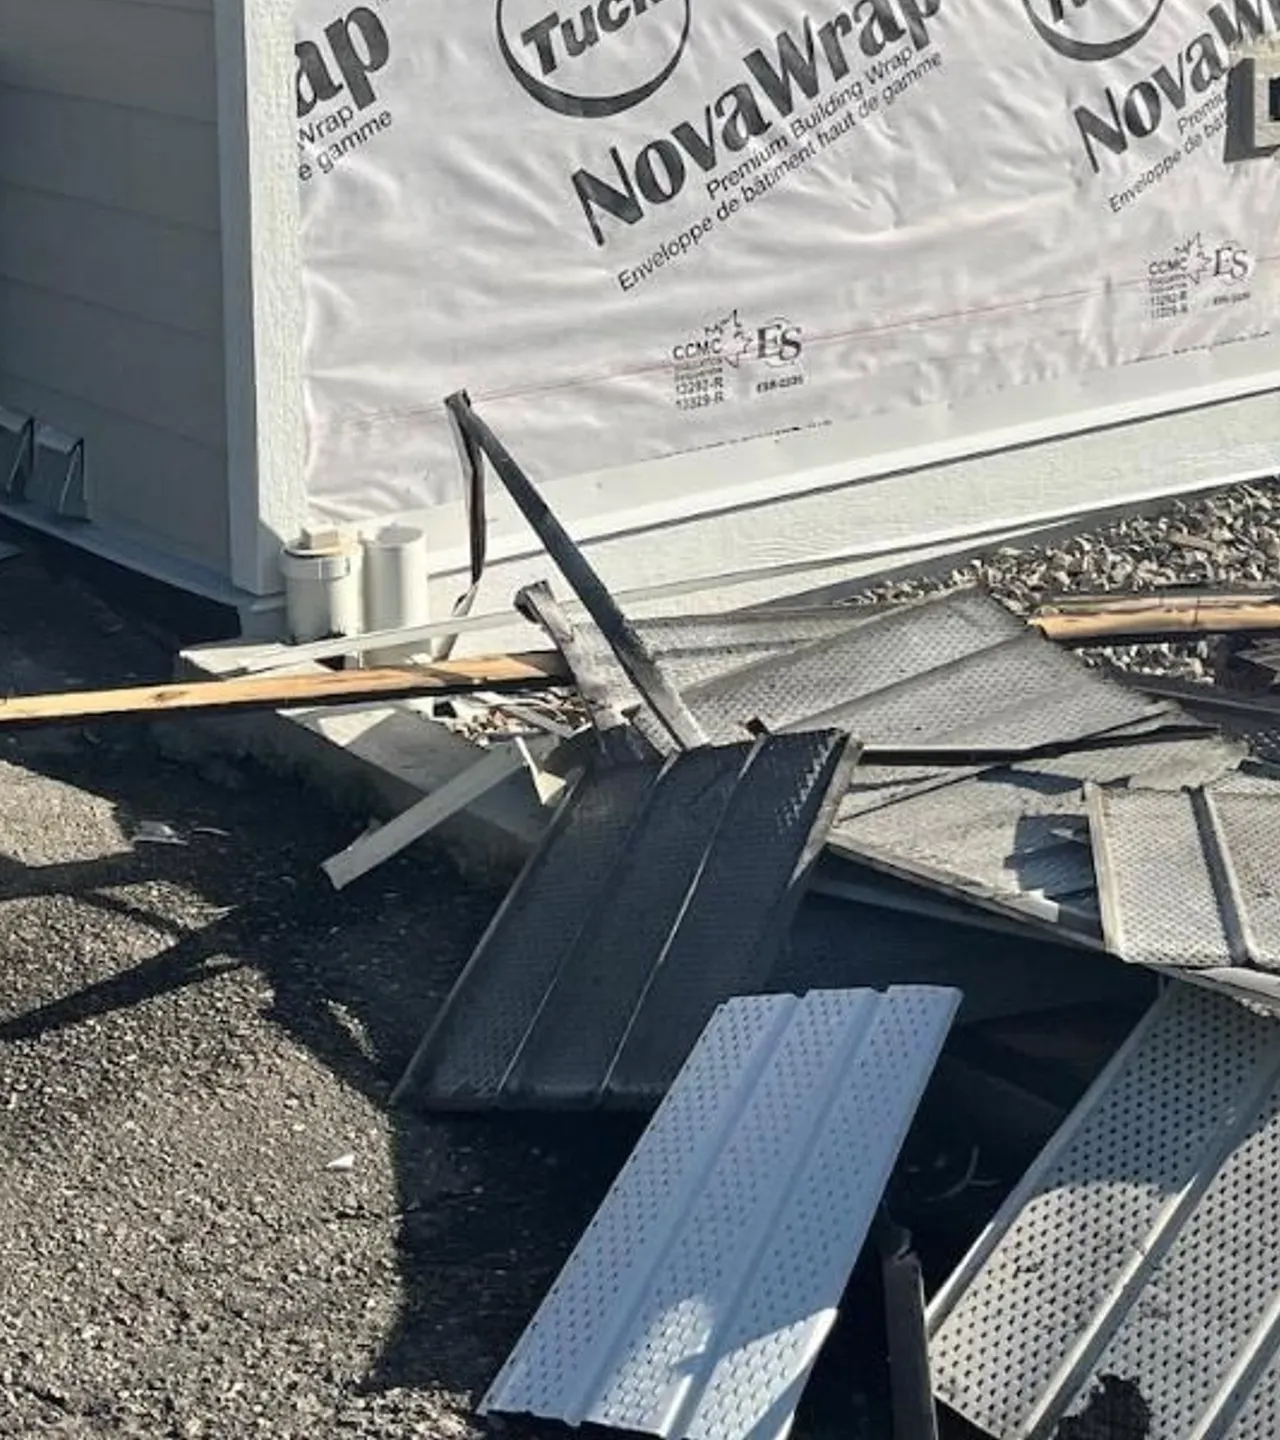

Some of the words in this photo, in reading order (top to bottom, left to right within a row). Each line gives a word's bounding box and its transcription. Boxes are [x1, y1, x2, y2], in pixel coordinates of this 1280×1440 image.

[316, 110, 393, 174] gamme
[705, 134, 790, 202] Premium
[789, 80, 865, 140] Building
[864, 45, 914, 92] Wrap
[617, 215, 714, 292] Enveloppe
[715, 196, 739, 223] de
[740, 141, 818, 203] bâtiment
[817, 108, 856, 151] haut
[856, 93, 880, 120] de
[880, 52, 943, 110] gamme
[1109, 149, 1182, 214] Enveloppe
[1183, 134, 1204, 155] de
[672, 337, 721, 361] CCMC
[756, 323, 803, 362] ES
